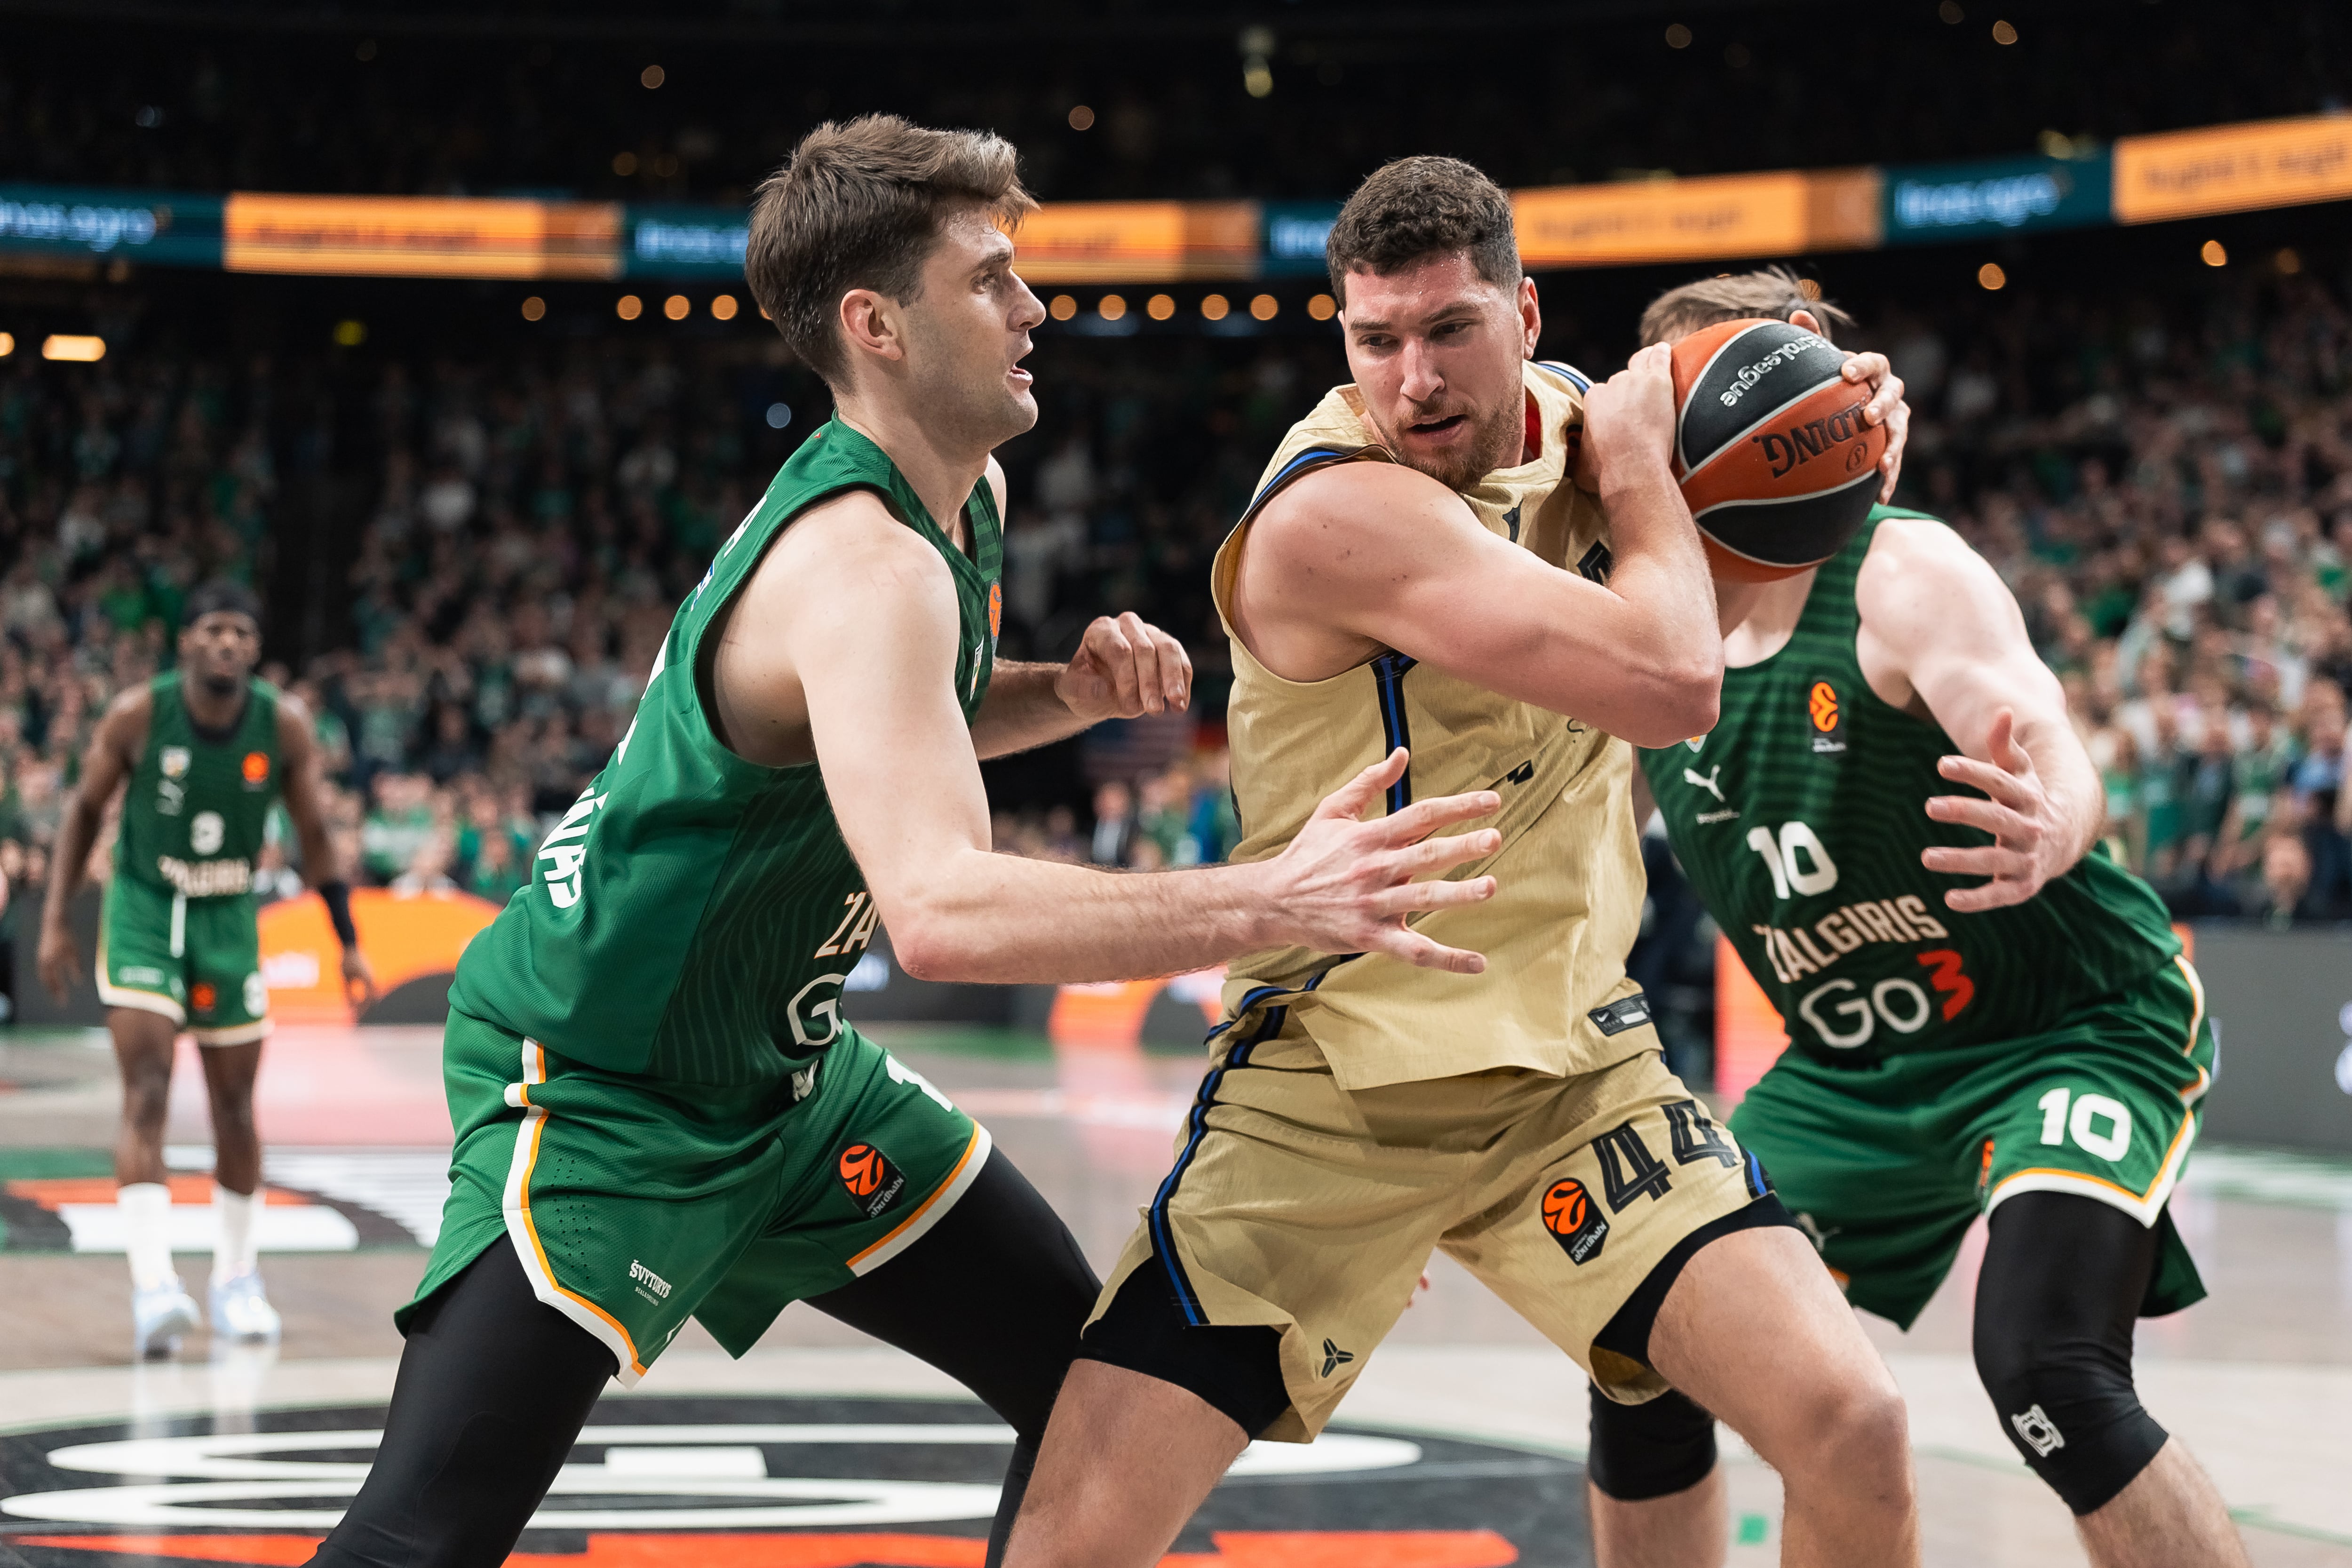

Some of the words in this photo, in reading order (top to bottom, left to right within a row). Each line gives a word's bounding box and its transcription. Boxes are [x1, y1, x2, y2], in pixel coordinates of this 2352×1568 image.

[1747, 821, 1838, 899] 10
[787, 973, 847, 1046] G
[1590, 1099, 1744, 1215] 44
[2038, 1087, 2132, 1162] 10
[629, 1259, 672, 1298] ŠVYTURYS
